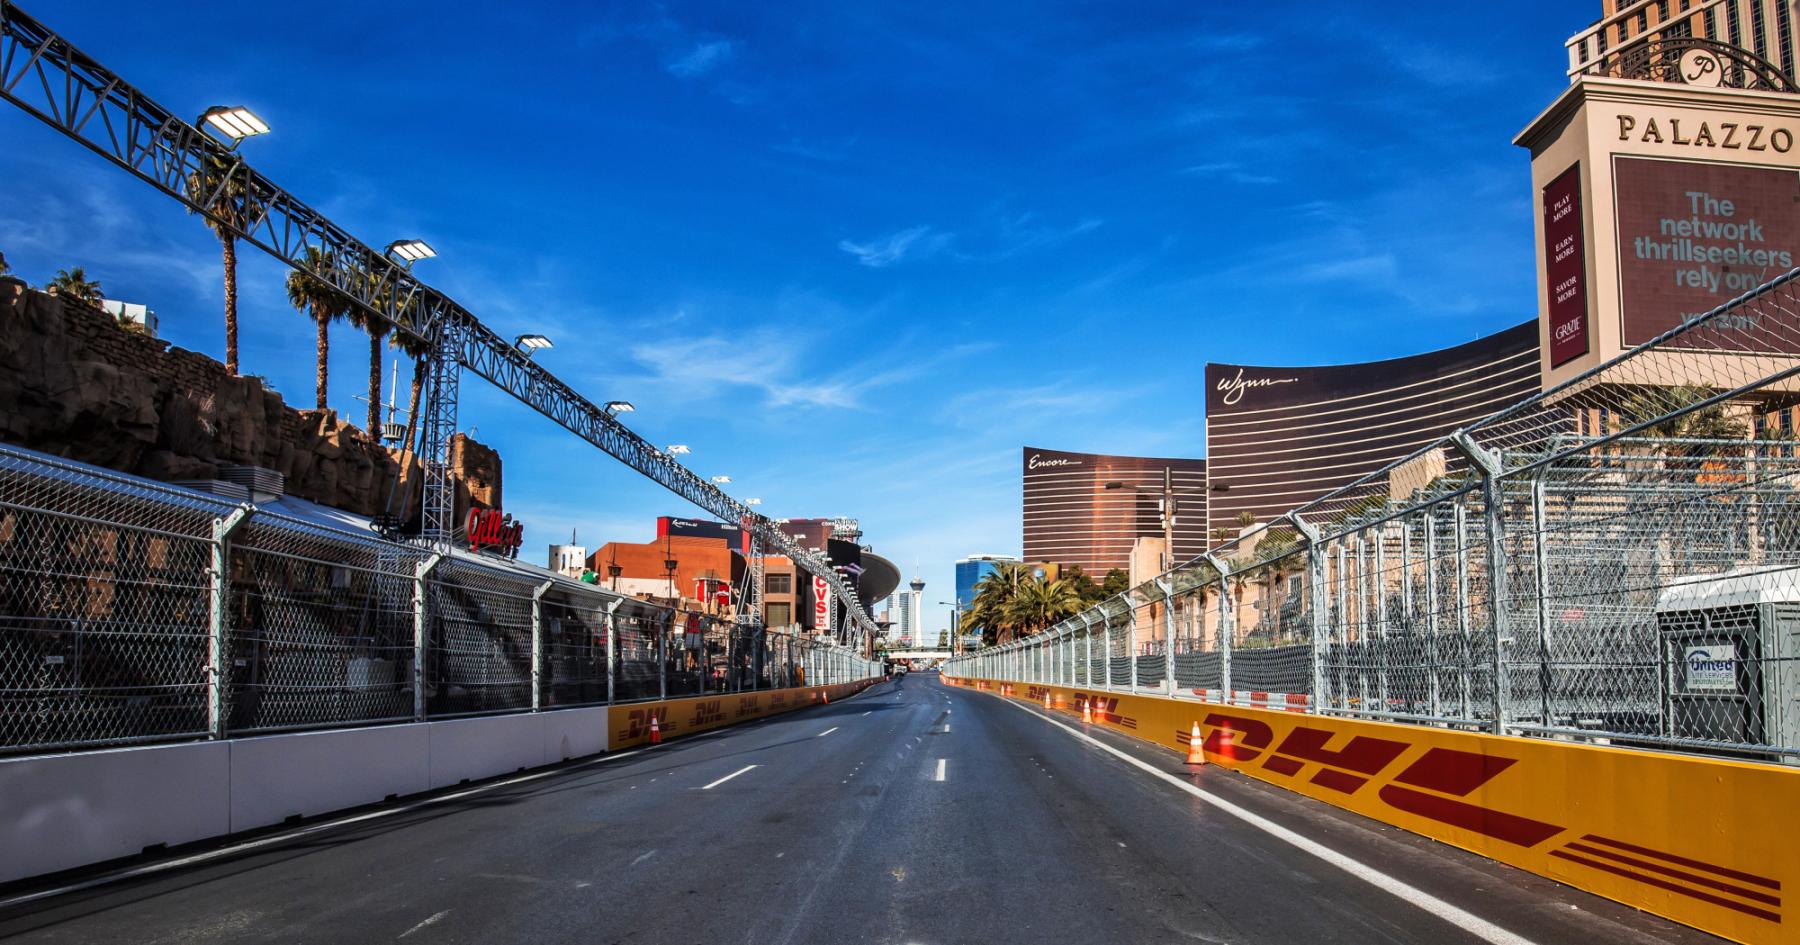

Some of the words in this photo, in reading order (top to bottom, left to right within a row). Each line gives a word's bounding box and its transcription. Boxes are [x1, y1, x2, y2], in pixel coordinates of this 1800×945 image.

[1616, 114, 1794, 153] PALAZZO
[1553, 204, 1572, 222] MORE
[1554, 194, 1570, 211] PLAY
[1686, 191, 1735, 217] The
[1660, 215, 1764, 242] network
[1555, 235, 1573, 252] EARN
[1555, 245, 1575, 263] MORE
[1635, 236, 1793, 268] thrillseekers
[1556, 276, 1577, 294] SAVOR
[1676, 265, 1721, 293] rely
[1725, 274, 1757, 290] on
[1557, 287, 1577, 304] MORE
[1555, 316, 1582, 340] GRAZIE
[1028, 454, 1082, 470] Encore
[815, 576, 827, 614] CVS
[1073, 693, 1123, 725] DHL
[627, 706, 670, 739] DHL
[1202, 712, 1568, 849] DHL
